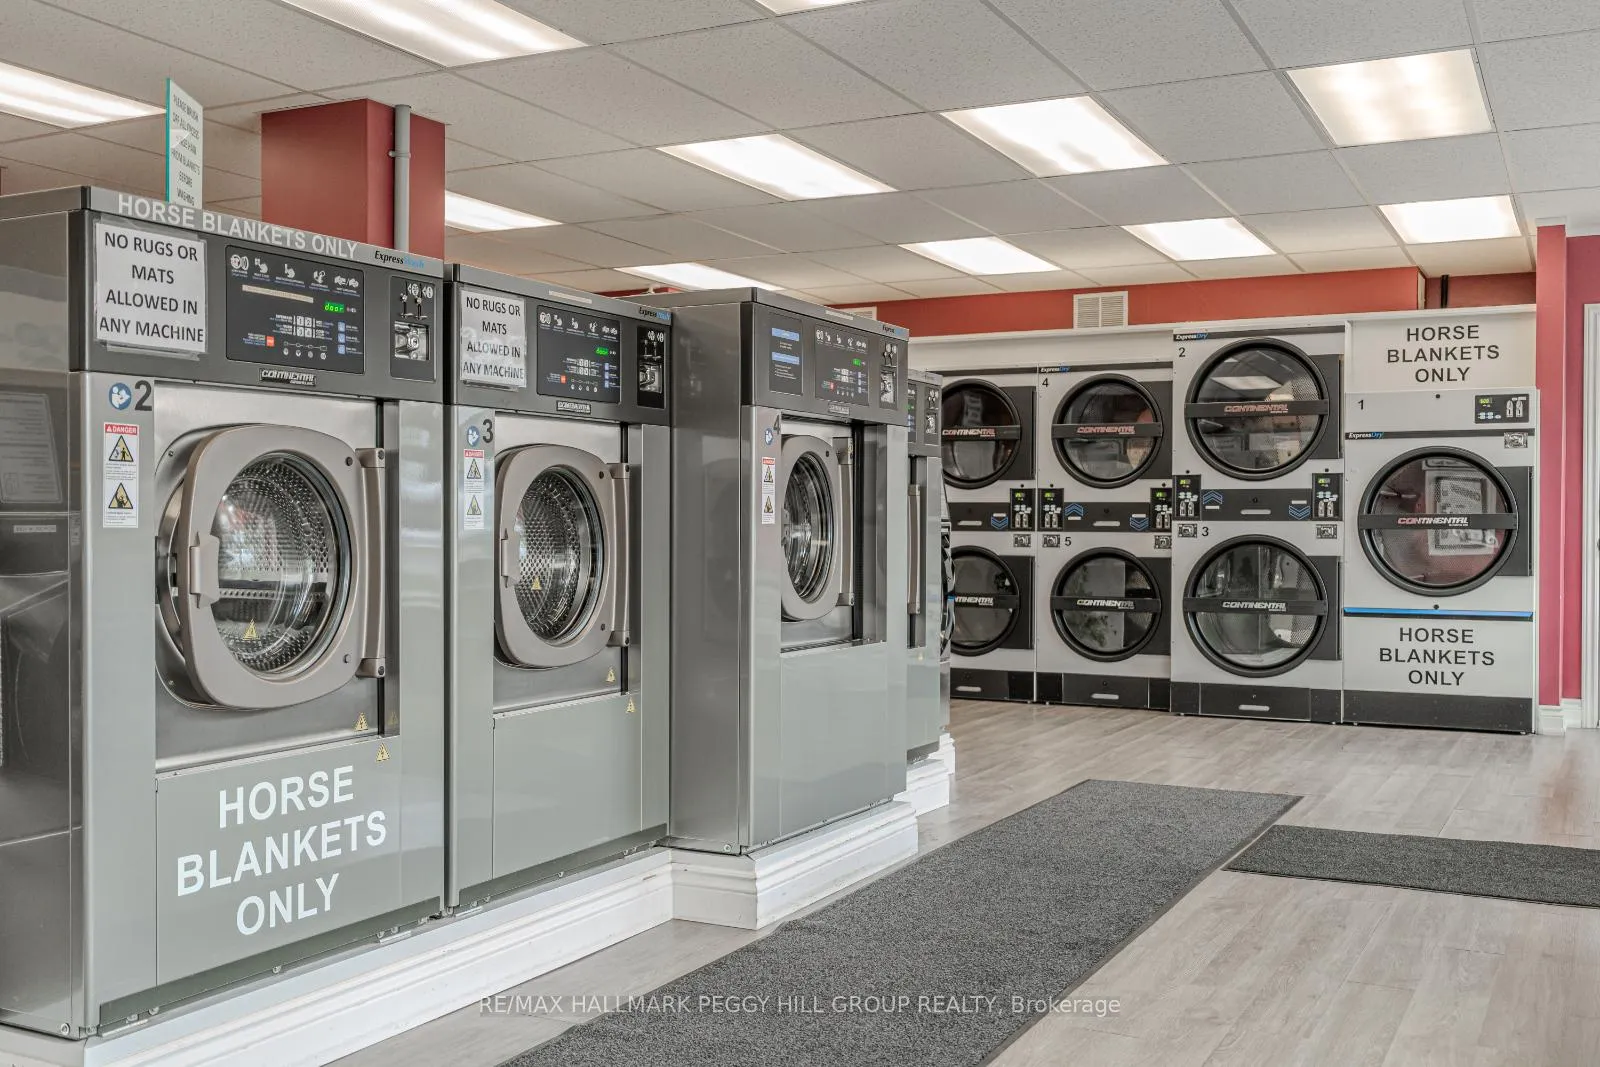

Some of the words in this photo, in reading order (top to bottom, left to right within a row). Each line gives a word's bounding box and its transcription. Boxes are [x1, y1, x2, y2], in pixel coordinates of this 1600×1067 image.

[118, 194, 195, 228] HORSE
[202, 212, 306, 249] BLANKETS
[312, 235, 359, 259] ONLY
[105, 231, 129, 249] NO
[133, 237, 174, 257] RUGS
[177, 245, 198, 262] OR
[131, 264, 174, 284] MATS
[105, 288, 179, 312] ALLOWED
[182, 299, 198, 315] IN
[324, 302, 344, 313] door
[466, 296, 480, 309] NO
[482, 299, 506, 314] RUGS
[508, 304, 521, 317] OR
[100, 316, 131, 334] ANY
[135, 320, 204, 343] MACHINE
[482, 320, 507, 335] MATS
[1407, 325, 1480, 342] HORSE
[466, 341, 509, 356] ALLOWED
[511, 346, 521, 358] IN
[1178, 346, 1186, 358] 2
[1387, 345, 1500, 363] BLANKETS
[463, 361, 481, 375] ANY
[483, 364, 524, 379] MACHINE
[1415, 367, 1470, 383] ONLY
[1041, 377, 1049, 388] 4
[134, 380, 152, 411] 2
[1223, 404, 1289, 413] CONTINENTAL
[1357, 400, 1364, 410] 1
[112, 426, 137, 434] DANGER
[482, 418, 494, 443] 3
[773, 413, 780, 435] 4
[1397, 517, 1469, 525] CONTINENTAL
[1201, 527, 1209, 537] 3
[1064, 536, 1072, 546] 5
[1076, 599, 1134, 607] CONTINENTAL
[1222, 601, 1286, 609] CONTINENTAL
[1399, 627, 1474, 644] HORSE
[1379, 647, 1495, 666] BLANKETS
[1408, 669, 1464, 686] ONLY
[219, 765, 354, 829] HORSE
[177, 810, 387, 896] BLANKETS
[236, 872, 340, 936] ONLY
